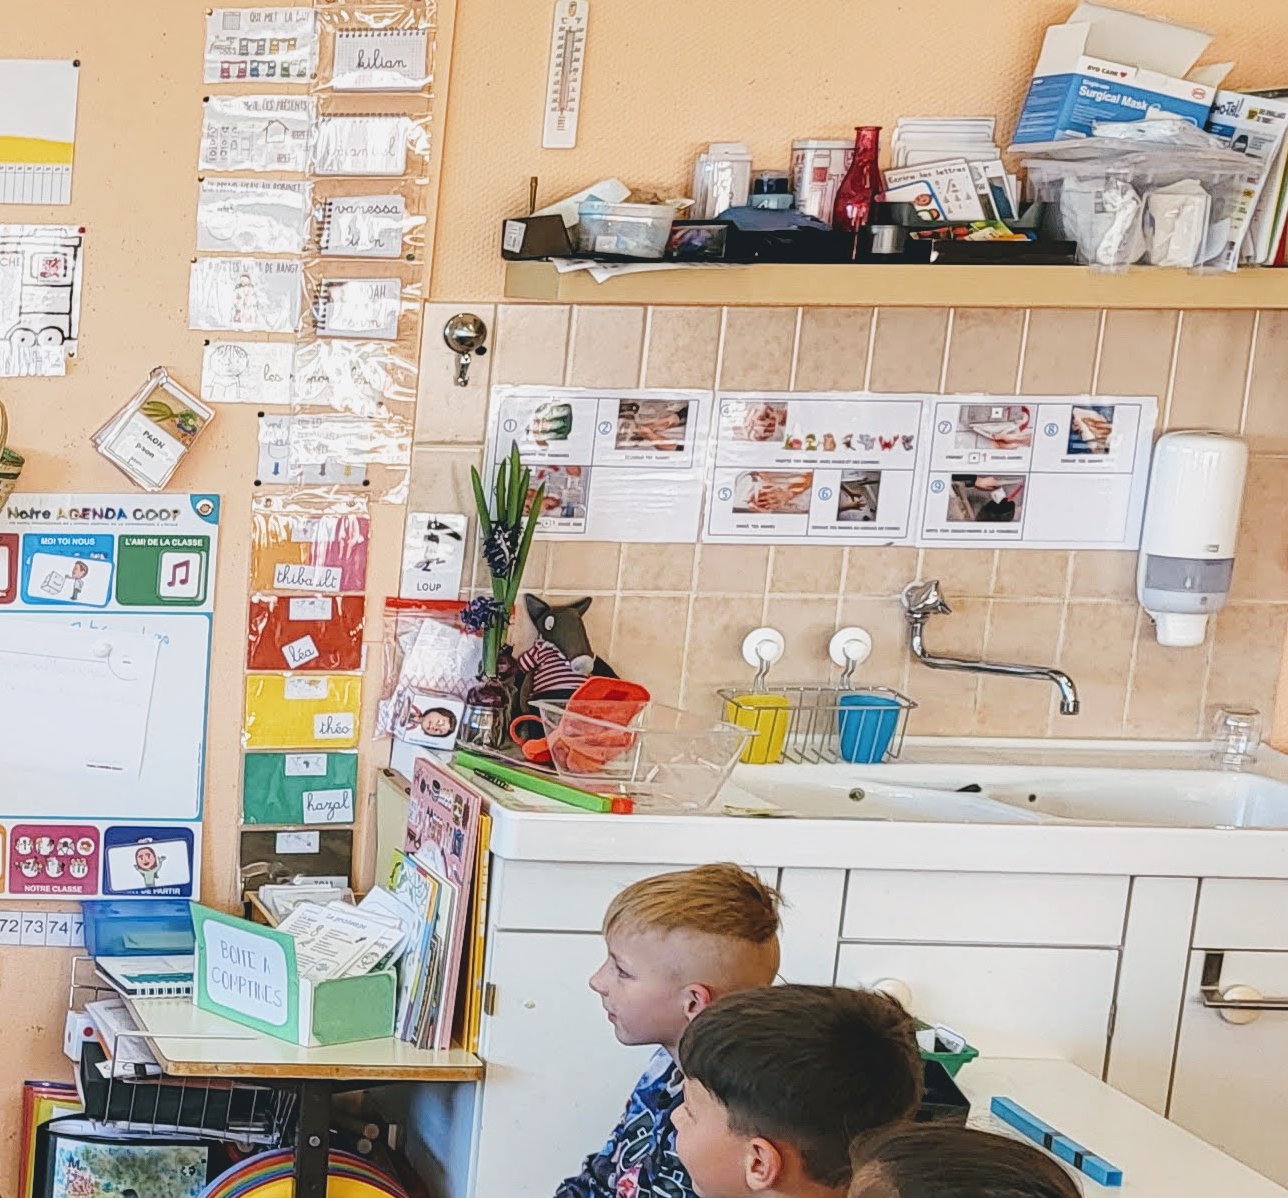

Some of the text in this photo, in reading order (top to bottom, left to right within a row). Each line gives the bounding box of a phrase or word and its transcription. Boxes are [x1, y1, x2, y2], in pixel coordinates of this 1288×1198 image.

[356, 49, 407, 69] kilian
[1079, 86, 1149, 111] Surgical Mask
[335, 203, 400, 215] vanessa
[141, 429, 167, 450] PAON
[6, 507, 51, 520] Notre
[56, 507, 128, 521] AGENDA
[41, 538, 95, 546] MOI TOI NOUS
[125, 538, 203, 548] L'AMI DE LA CLASSE
[416, 582, 442, 593] LOUP
[288, 645, 315, 663] léa
[318, 715, 352, 737] théo
[306, 790, 350, 821] hazal
[25, 884, 82, 894] NOTRE CLASSE
[24, 920, 44, 934] 73
[48, 921, 69, 936] 74
[212, 966, 283, 1008] COMPTINES
